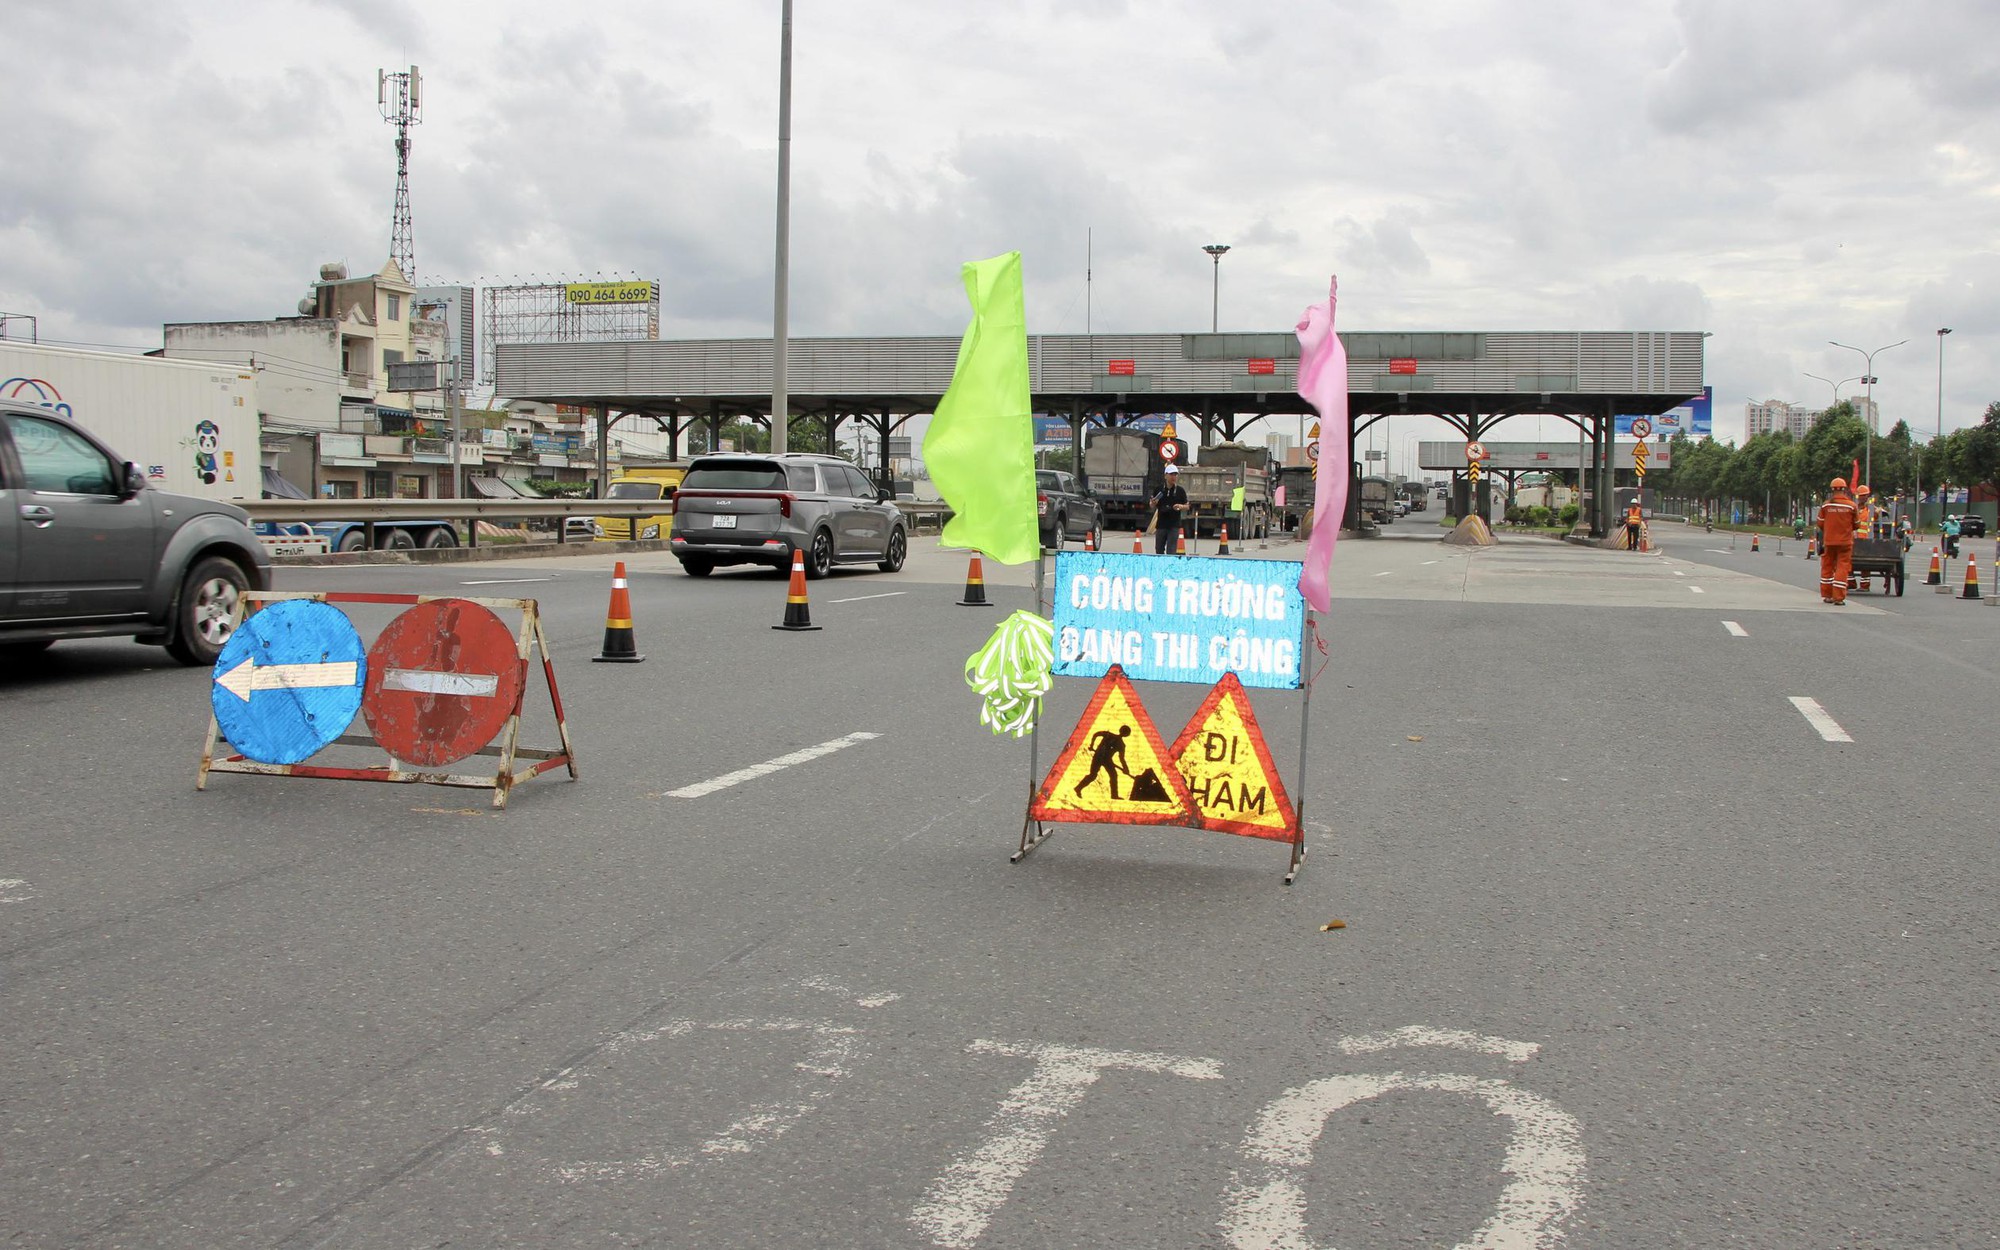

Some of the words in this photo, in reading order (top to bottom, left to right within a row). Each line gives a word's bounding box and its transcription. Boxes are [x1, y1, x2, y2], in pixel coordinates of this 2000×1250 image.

[570, 290, 591, 301] 090
[594, 289, 615, 301] 464
[619, 288, 648, 300] 6699
[1070, 568, 1153, 612] CÔNG
[1163, 574, 1285, 621] TRƯỜNG
[1152, 632, 1199, 669] THI
[1208, 629, 1293, 675] CÔNG
[1204, 732, 1238, 764] ĐI
[1189, 773, 1266, 817] HẬM
